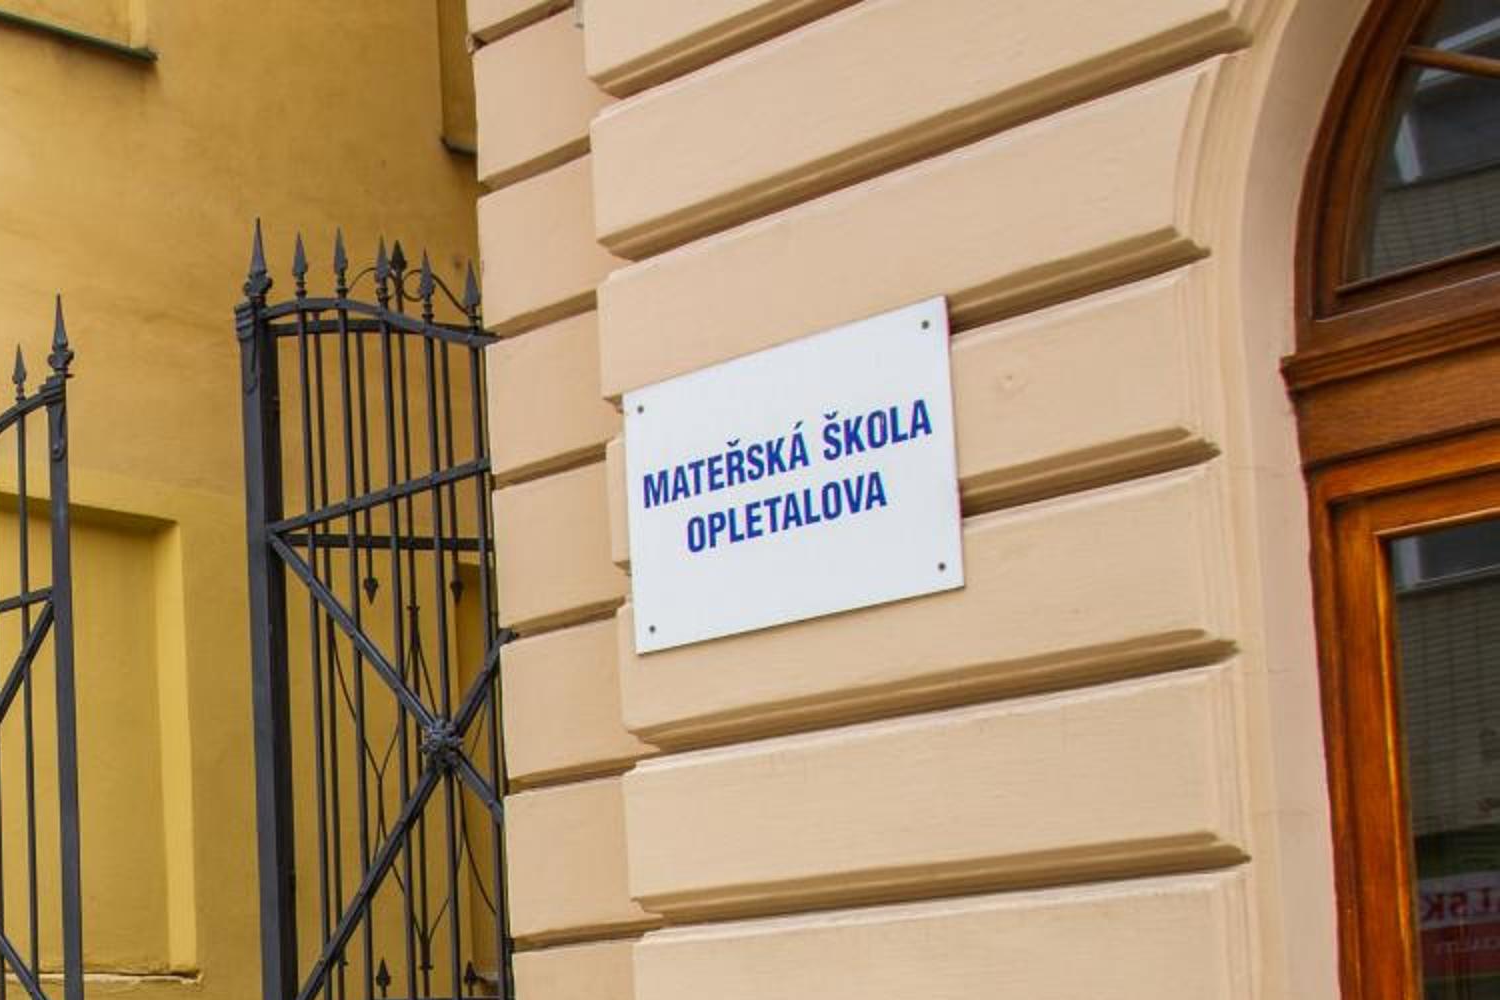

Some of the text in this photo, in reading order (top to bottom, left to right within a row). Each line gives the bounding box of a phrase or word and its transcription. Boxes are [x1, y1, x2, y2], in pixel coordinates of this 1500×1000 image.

[643, 399, 932, 509] MATEŘSKÁ ŠKOLA
[687, 472, 887, 553] OPLETALOVA
